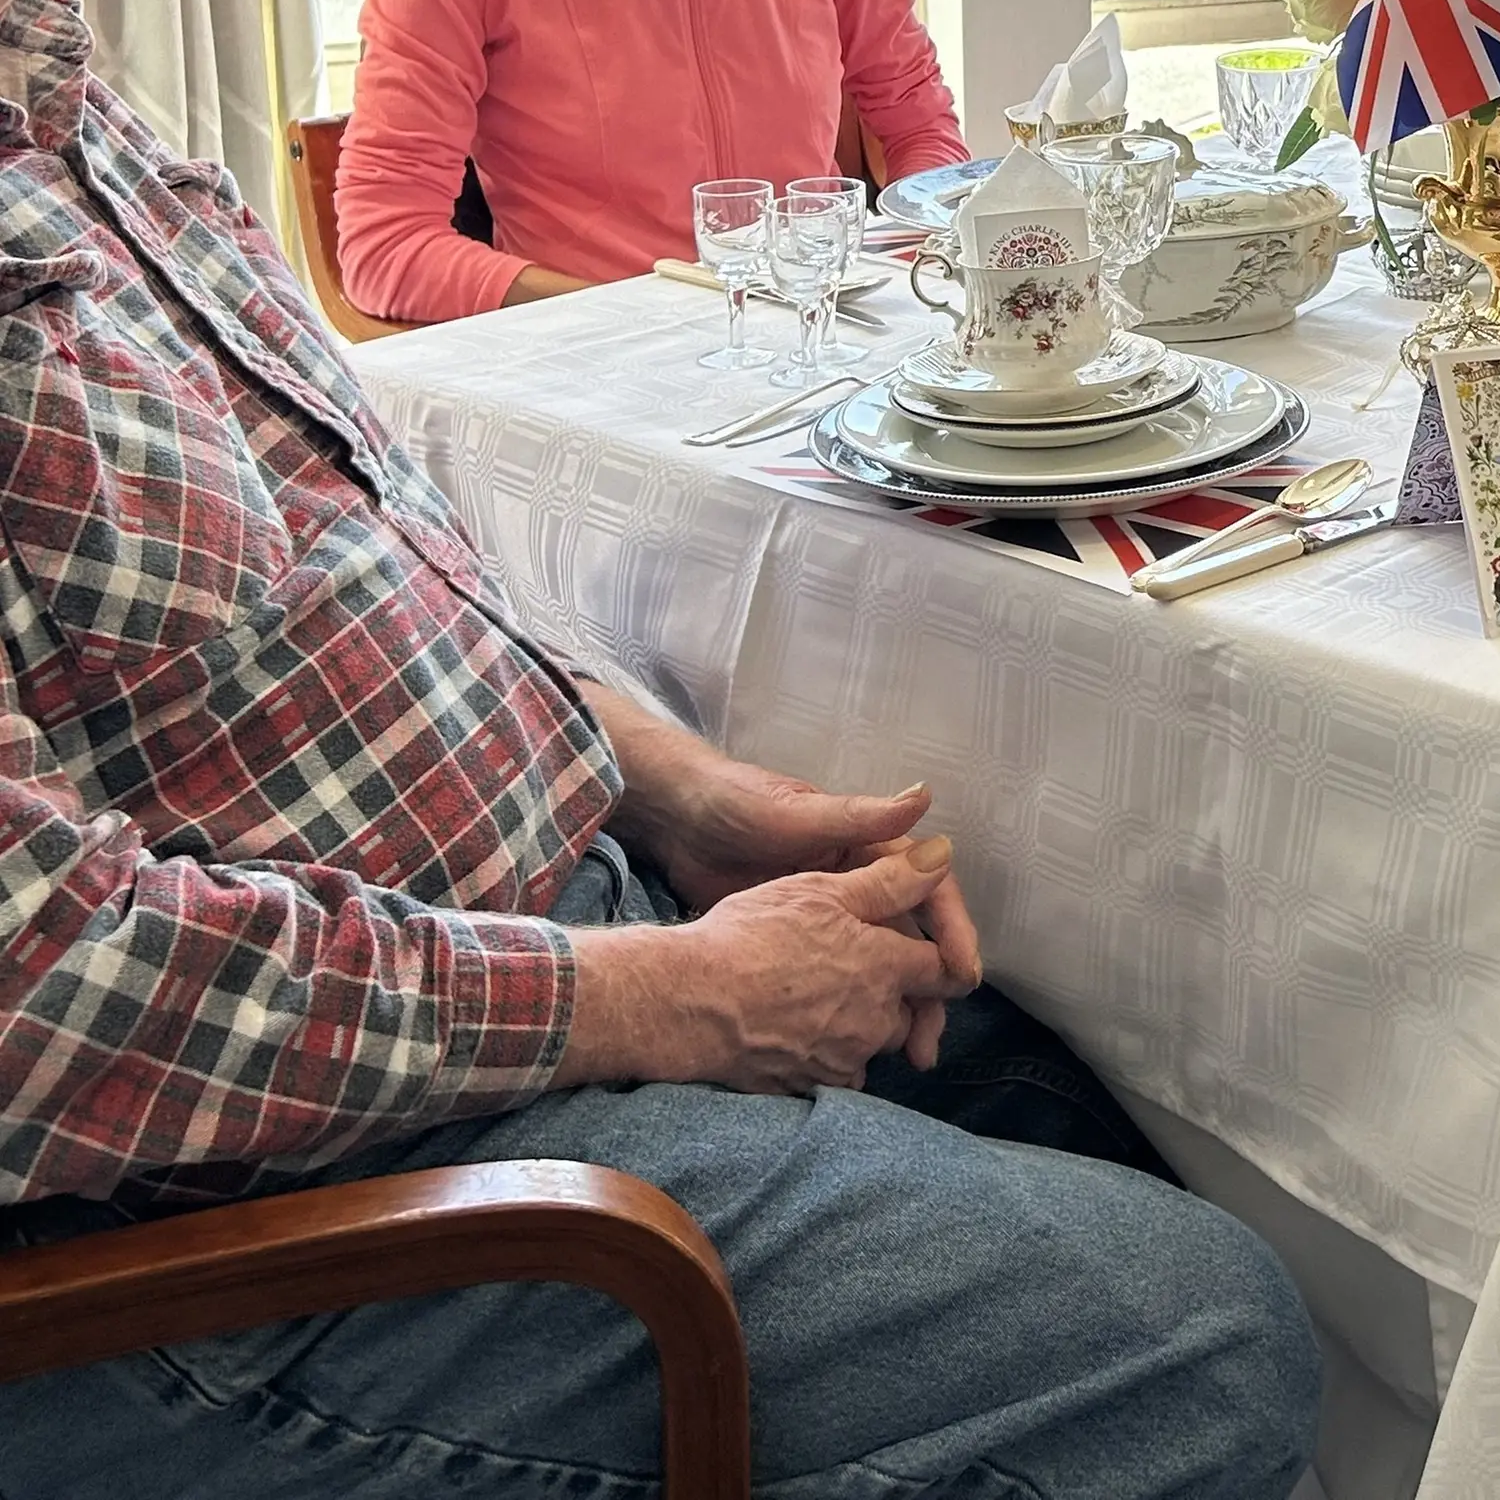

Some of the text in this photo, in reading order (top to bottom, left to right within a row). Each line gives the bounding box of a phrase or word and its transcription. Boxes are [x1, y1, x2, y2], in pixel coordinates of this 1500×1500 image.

[989, 224, 1072, 255] KING CHARLES III
